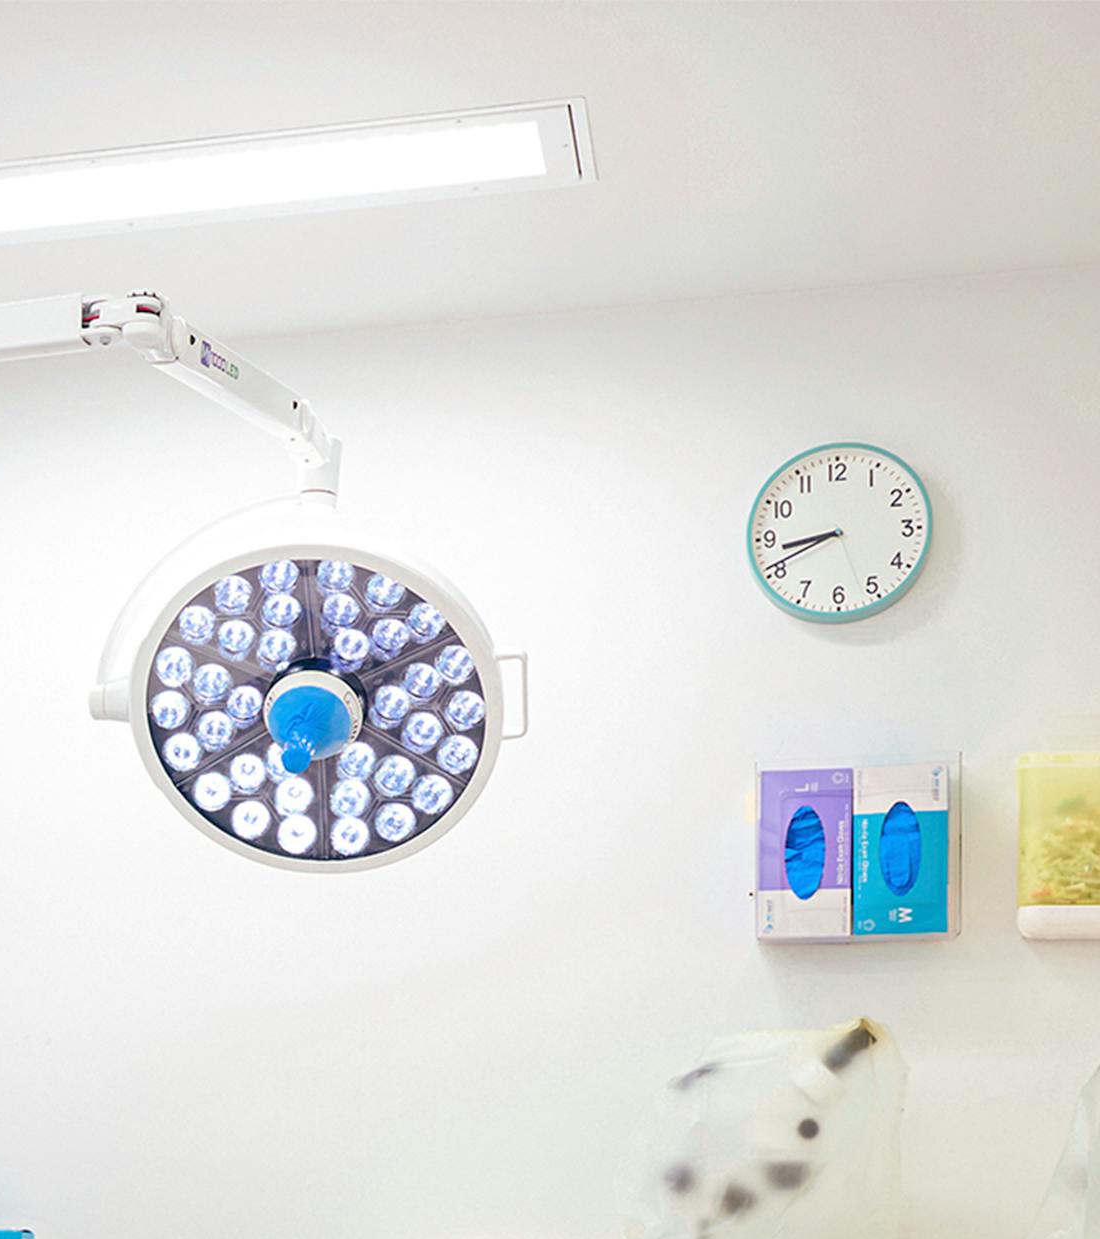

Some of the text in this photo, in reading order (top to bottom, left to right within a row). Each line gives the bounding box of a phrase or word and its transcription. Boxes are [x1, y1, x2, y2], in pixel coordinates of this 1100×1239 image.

[828, 462, 847, 482] 12
[869, 469, 874, 487] 1
[800, 475, 811, 493] 11
[890, 488, 903, 507] 2
[774, 500, 792, 519] 10
[901, 519, 914, 538] 3
[763, 530, 776, 548] 9
[890, 552, 903, 569] 4
[774, 561, 787, 579] 8
[800, 580, 812, 598] 7
[866, 576, 879, 594] 5
[832, 586, 845, 604] 6
[898, 906, 913, 923] M
